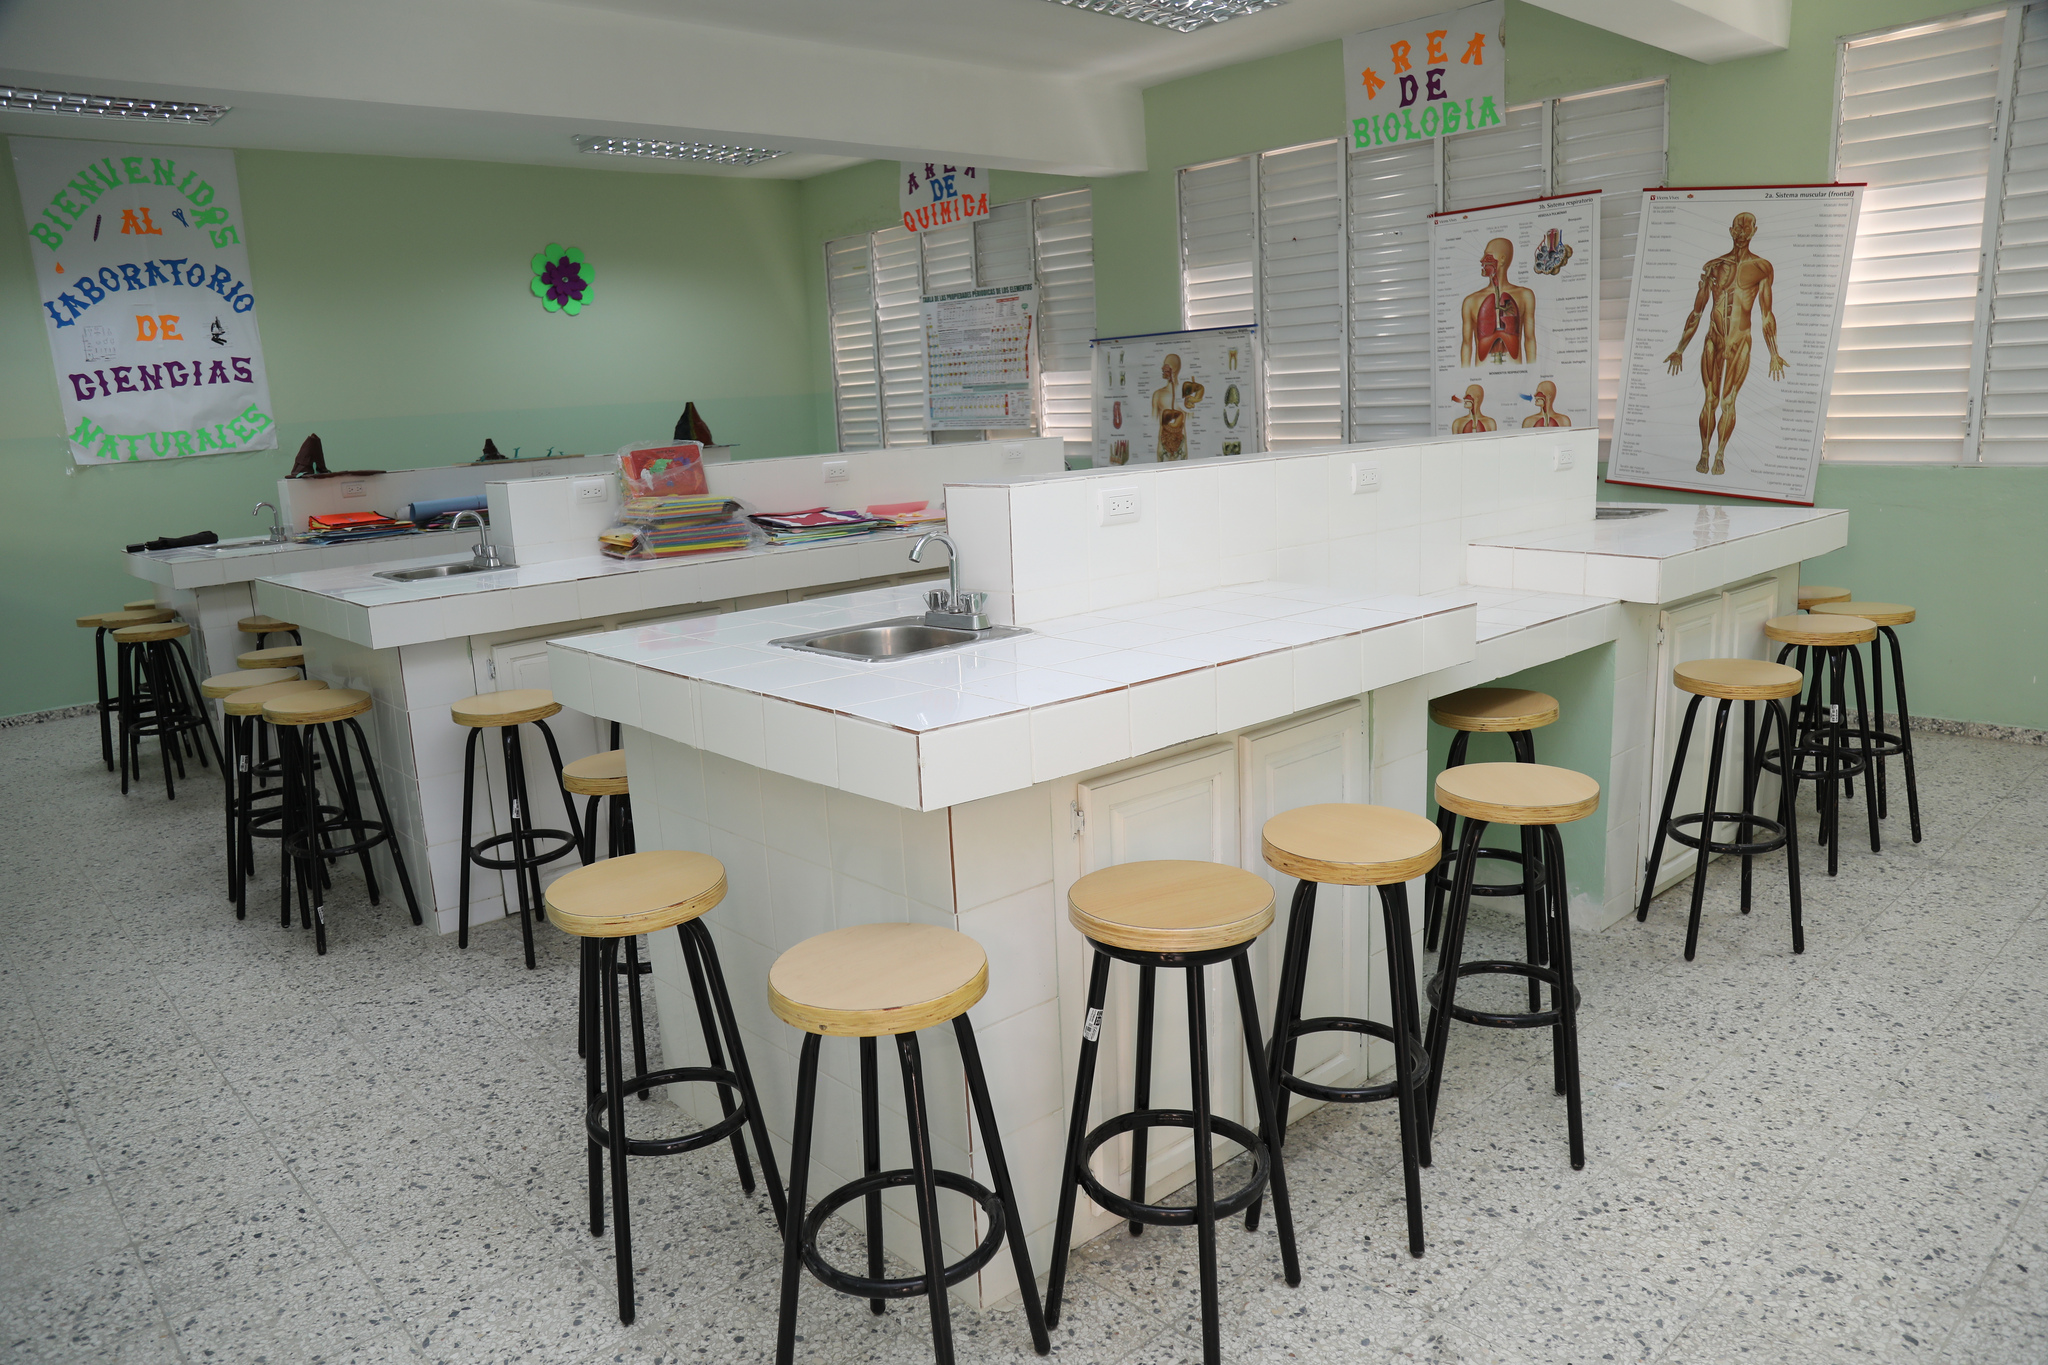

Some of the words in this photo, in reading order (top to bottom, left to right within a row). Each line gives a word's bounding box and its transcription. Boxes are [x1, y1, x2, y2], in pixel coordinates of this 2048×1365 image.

[1362, 29, 1486, 101] AREA
[1399, 68, 1448, 108] DE
[1352, 95, 1501, 149] BIOLOGIA
[929, 174, 958, 202] DE
[1546, 201, 1565, 209] Sistema
[1565, 197, 1594, 206] respiratorio
[1775, 191, 1799, 199] Sistema
[1799, 190, 1827, 198] muscular
[120, 206, 163, 236] AL
[903, 193, 989, 233] QUIMICA
[44, 257, 255, 329] LABORATORIO
[135, 314, 184, 342] DE
[69, 356, 254, 401] CIENCIAS
[69, 403, 274, 461] NATURALES
